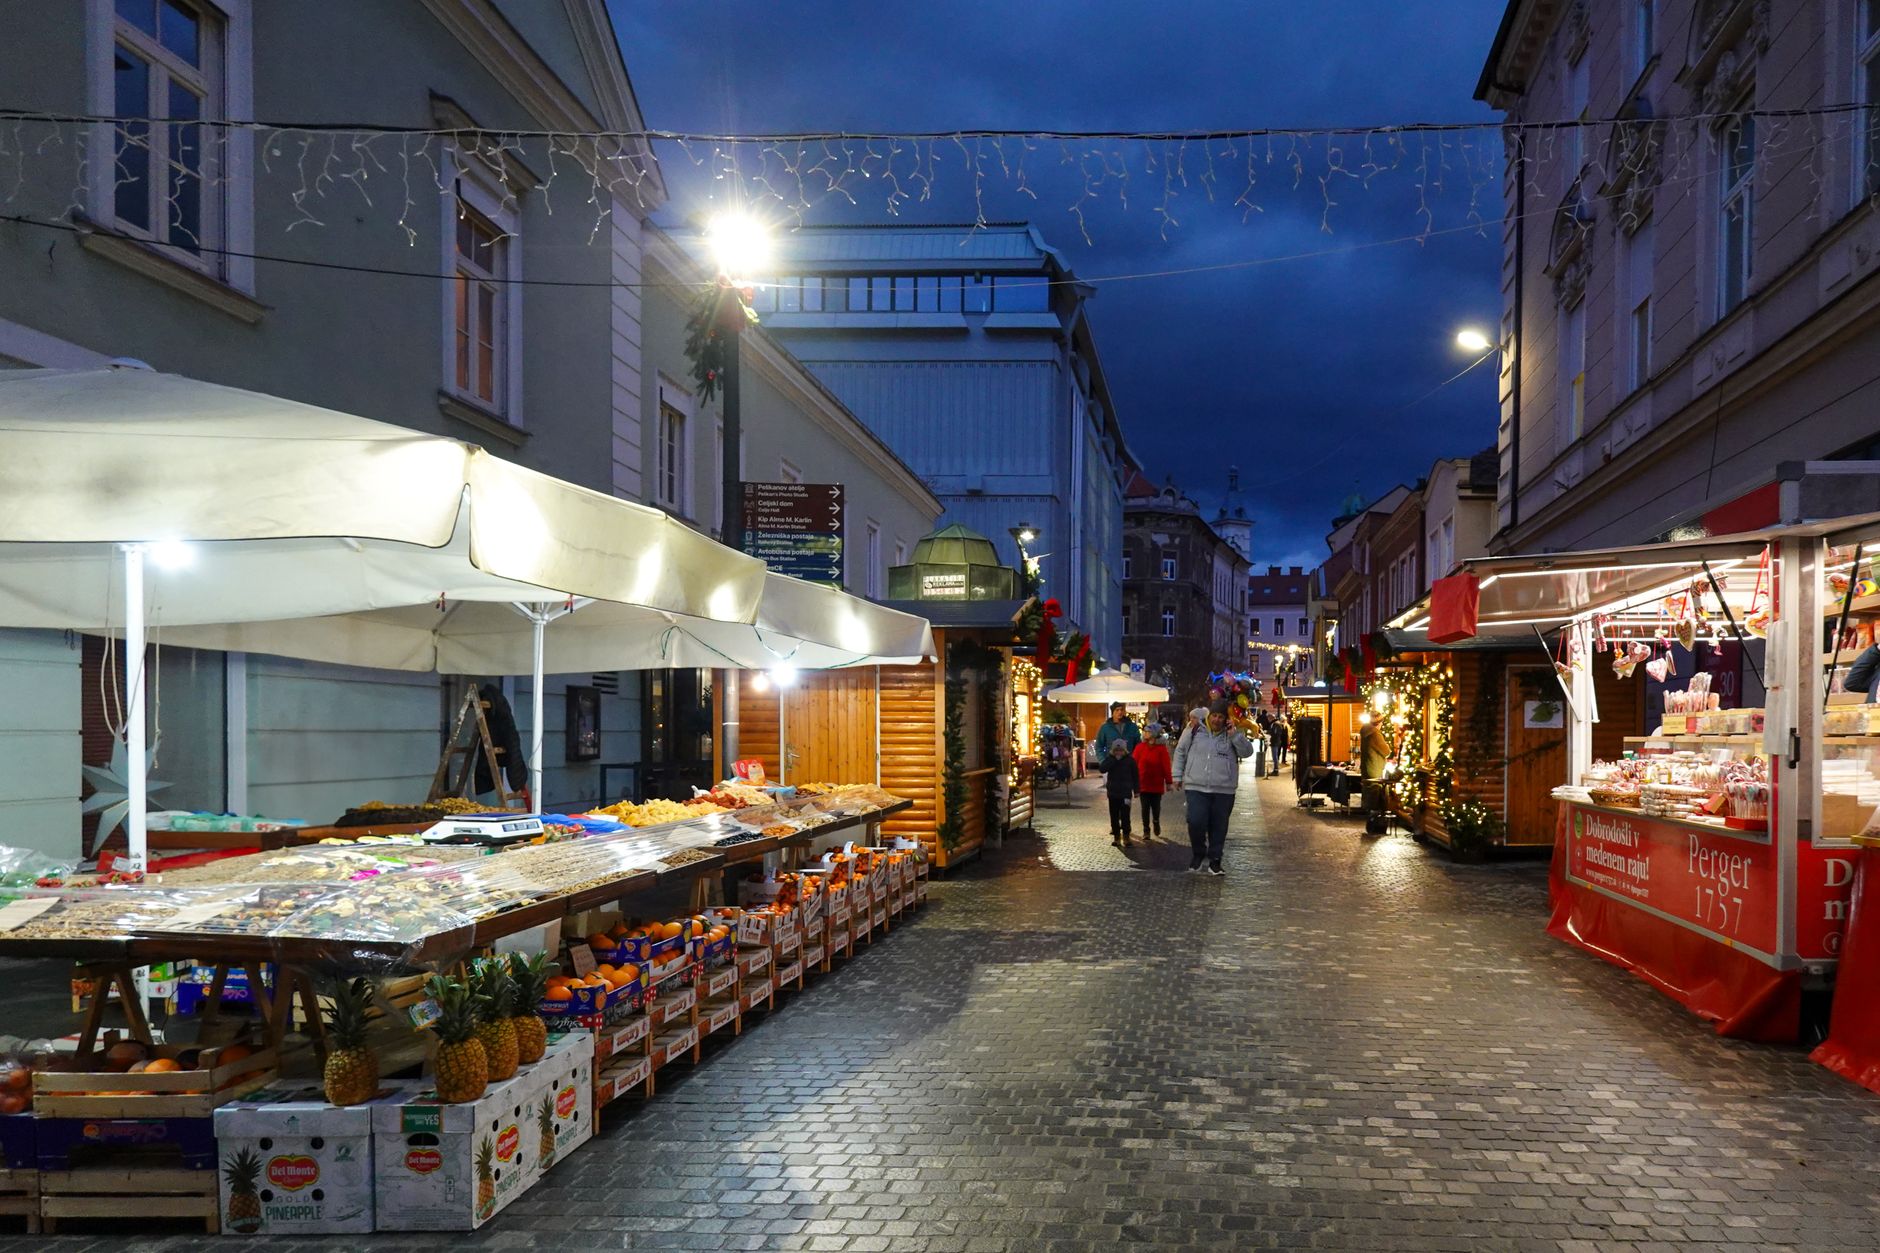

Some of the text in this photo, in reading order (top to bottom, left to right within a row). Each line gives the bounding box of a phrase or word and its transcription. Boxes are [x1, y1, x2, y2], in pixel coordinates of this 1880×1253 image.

[758, 531, 790, 539] Železniška
[1586, 814, 1640, 848] Dobrodošli v
[1586, 842, 1650, 884] medenem raju!
[1688, 833, 1752, 898] Perger
[1695, 885, 1743, 935] 1757
[271, 1165, 316, 1176] Del Monte
[277, 1195, 311, 1204] GOLD
[265, 1205, 323, 1220] PINEAPPLE
